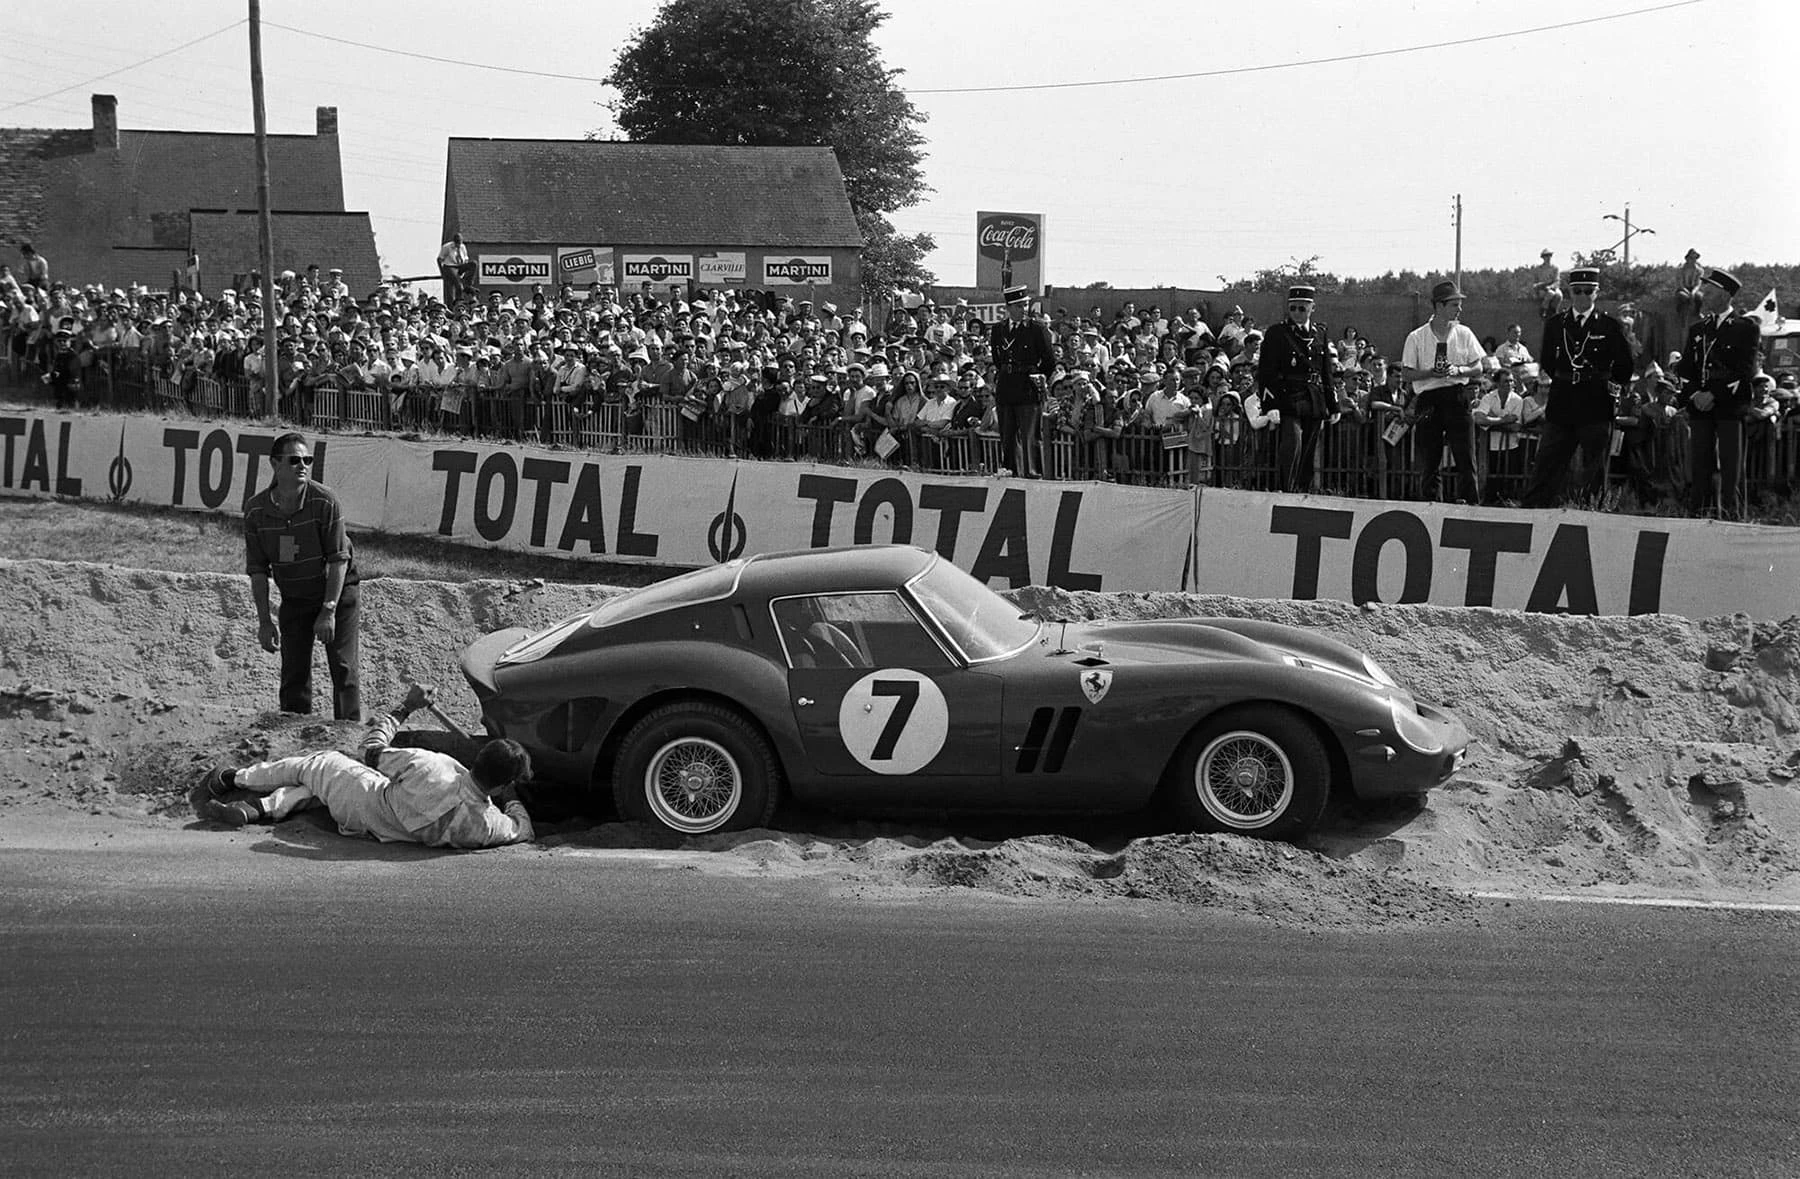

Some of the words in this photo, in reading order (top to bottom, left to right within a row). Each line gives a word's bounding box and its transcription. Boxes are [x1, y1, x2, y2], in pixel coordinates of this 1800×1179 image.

[564, 254, 594, 268] LIEBIG
[485, 264, 546, 275] MARTINI
[628, 264, 688, 275] MARTINI
[700, 263, 745, 273] CLARVILLE
[769, 265, 827, 276] MARTINI
[432, 450, 659, 557] TOTAL
[798, 473, 1103, 593] TOTAL
[870, 679, 920, 760] 7
